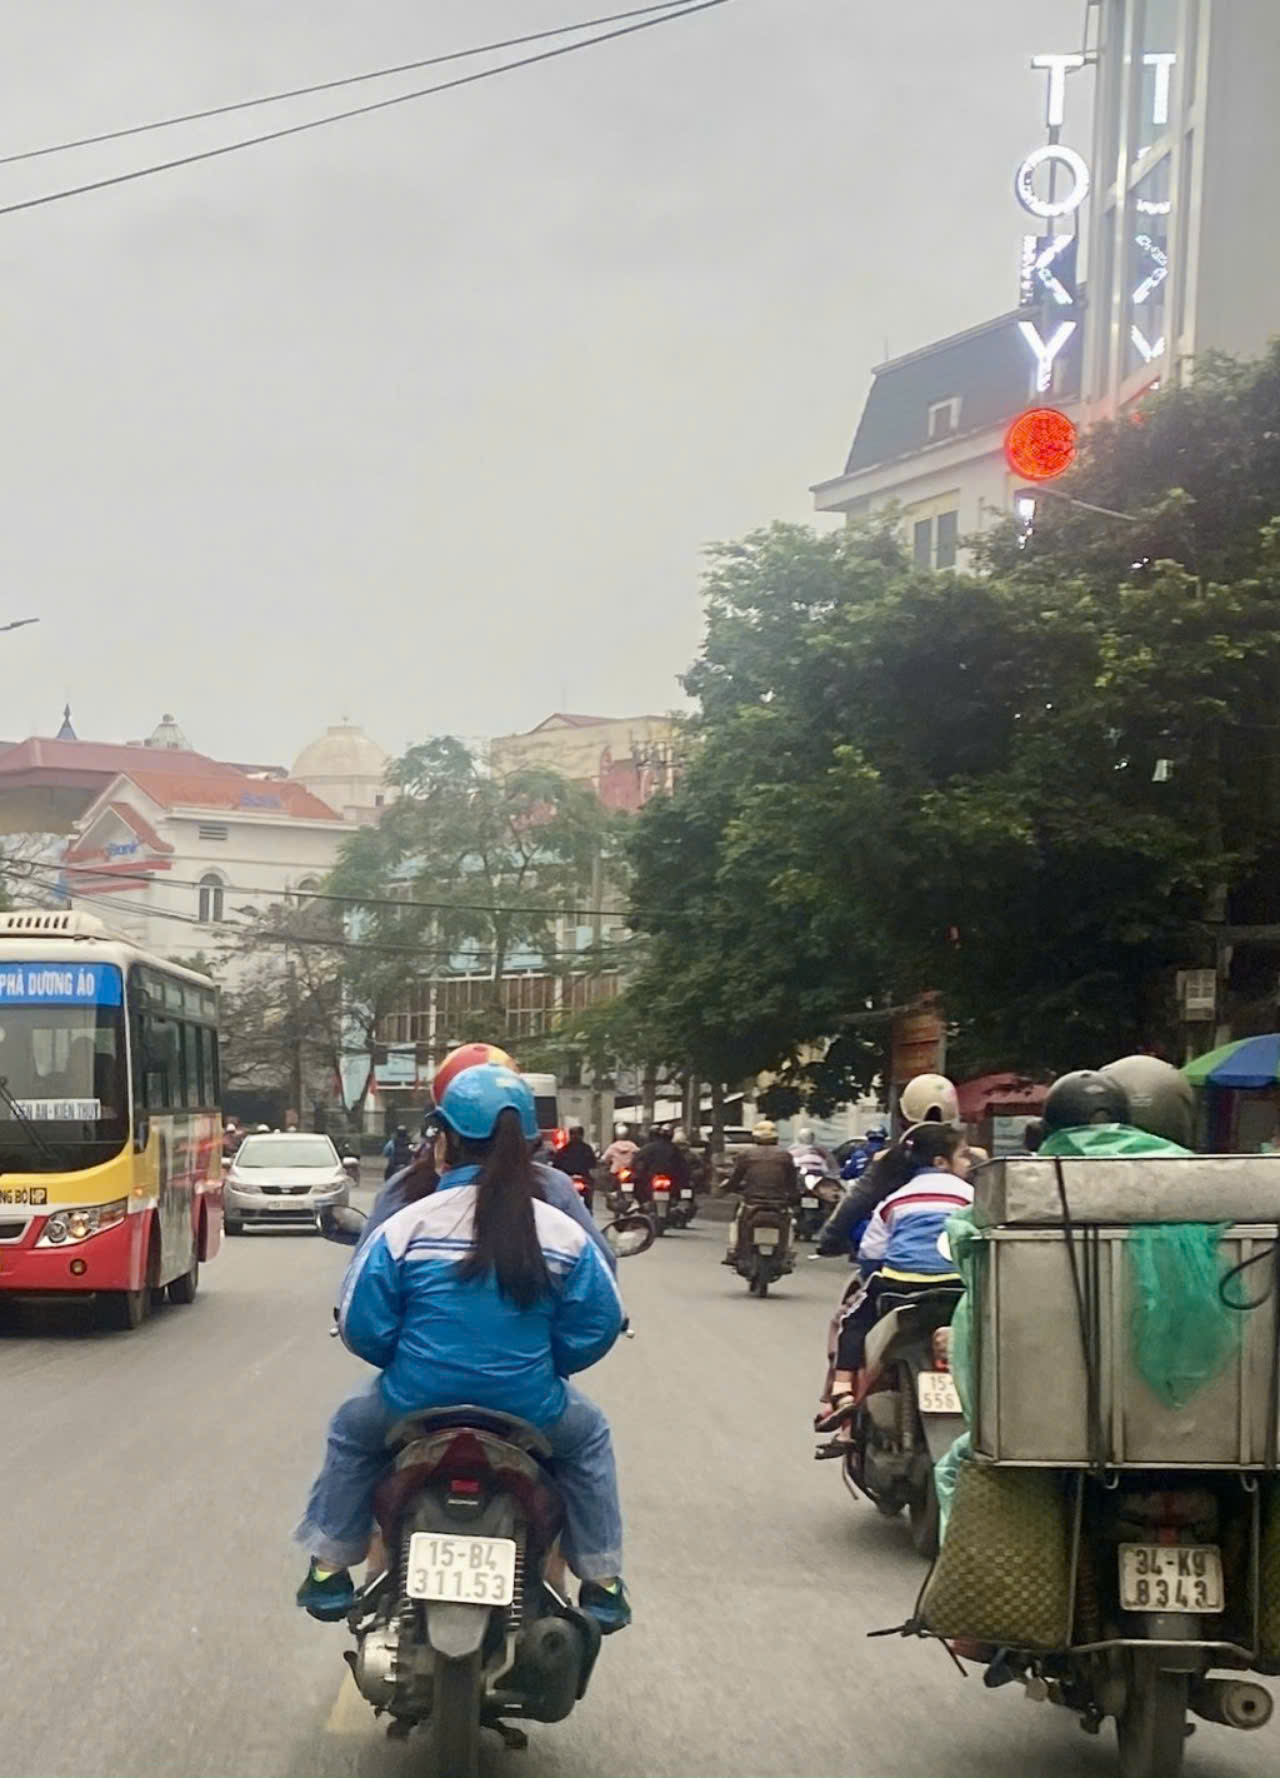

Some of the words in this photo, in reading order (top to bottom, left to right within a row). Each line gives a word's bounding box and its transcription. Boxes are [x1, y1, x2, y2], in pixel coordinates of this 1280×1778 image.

[428, 1541, 497, 1570] 15-B4
[1135, 1548, 1207, 1578] 34-K9
[414, 1568, 506, 1600] 311.53
[1135, 1578, 1208, 1609] 8343
